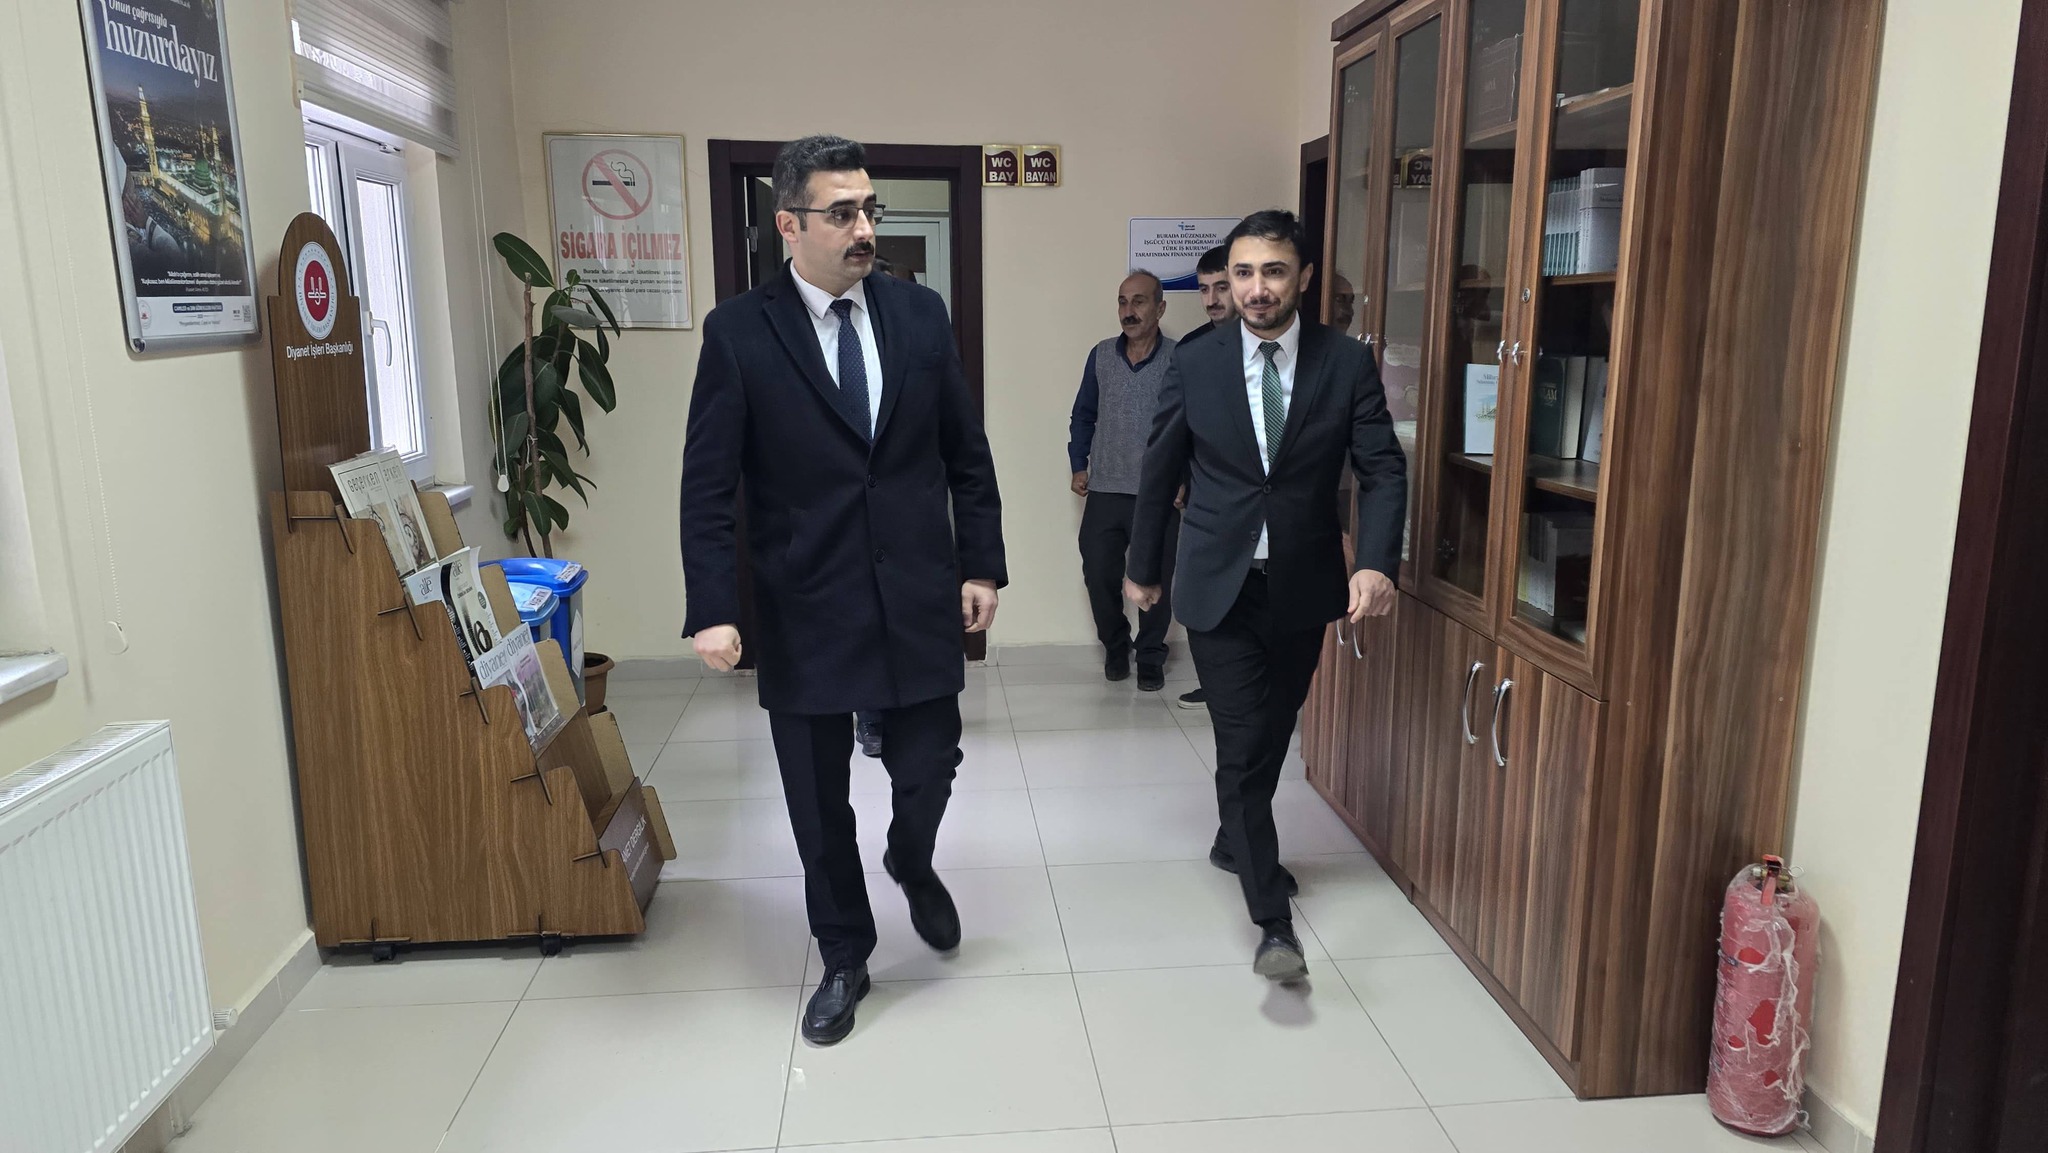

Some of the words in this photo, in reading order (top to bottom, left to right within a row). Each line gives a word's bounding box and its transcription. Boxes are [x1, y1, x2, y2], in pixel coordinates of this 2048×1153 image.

[132, 6, 168, 29] çağrısıyla
[101, 0, 218, 88] huzurdayız
[991, 157, 1012, 168] WC
[1030, 157, 1051, 168] WC
[989, 171, 1014, 182] BAY
[1026, 171, 1056, 182] BAYAN
[560, 224, 618, 260] SİGARA
[621, 224, 682, 268] İÇİLMEZ
[286, 344, 310, 360] Diyanet
[310, 341, 325, 359] İşleri
[325, 340, 353, 357] Başkanlığı
